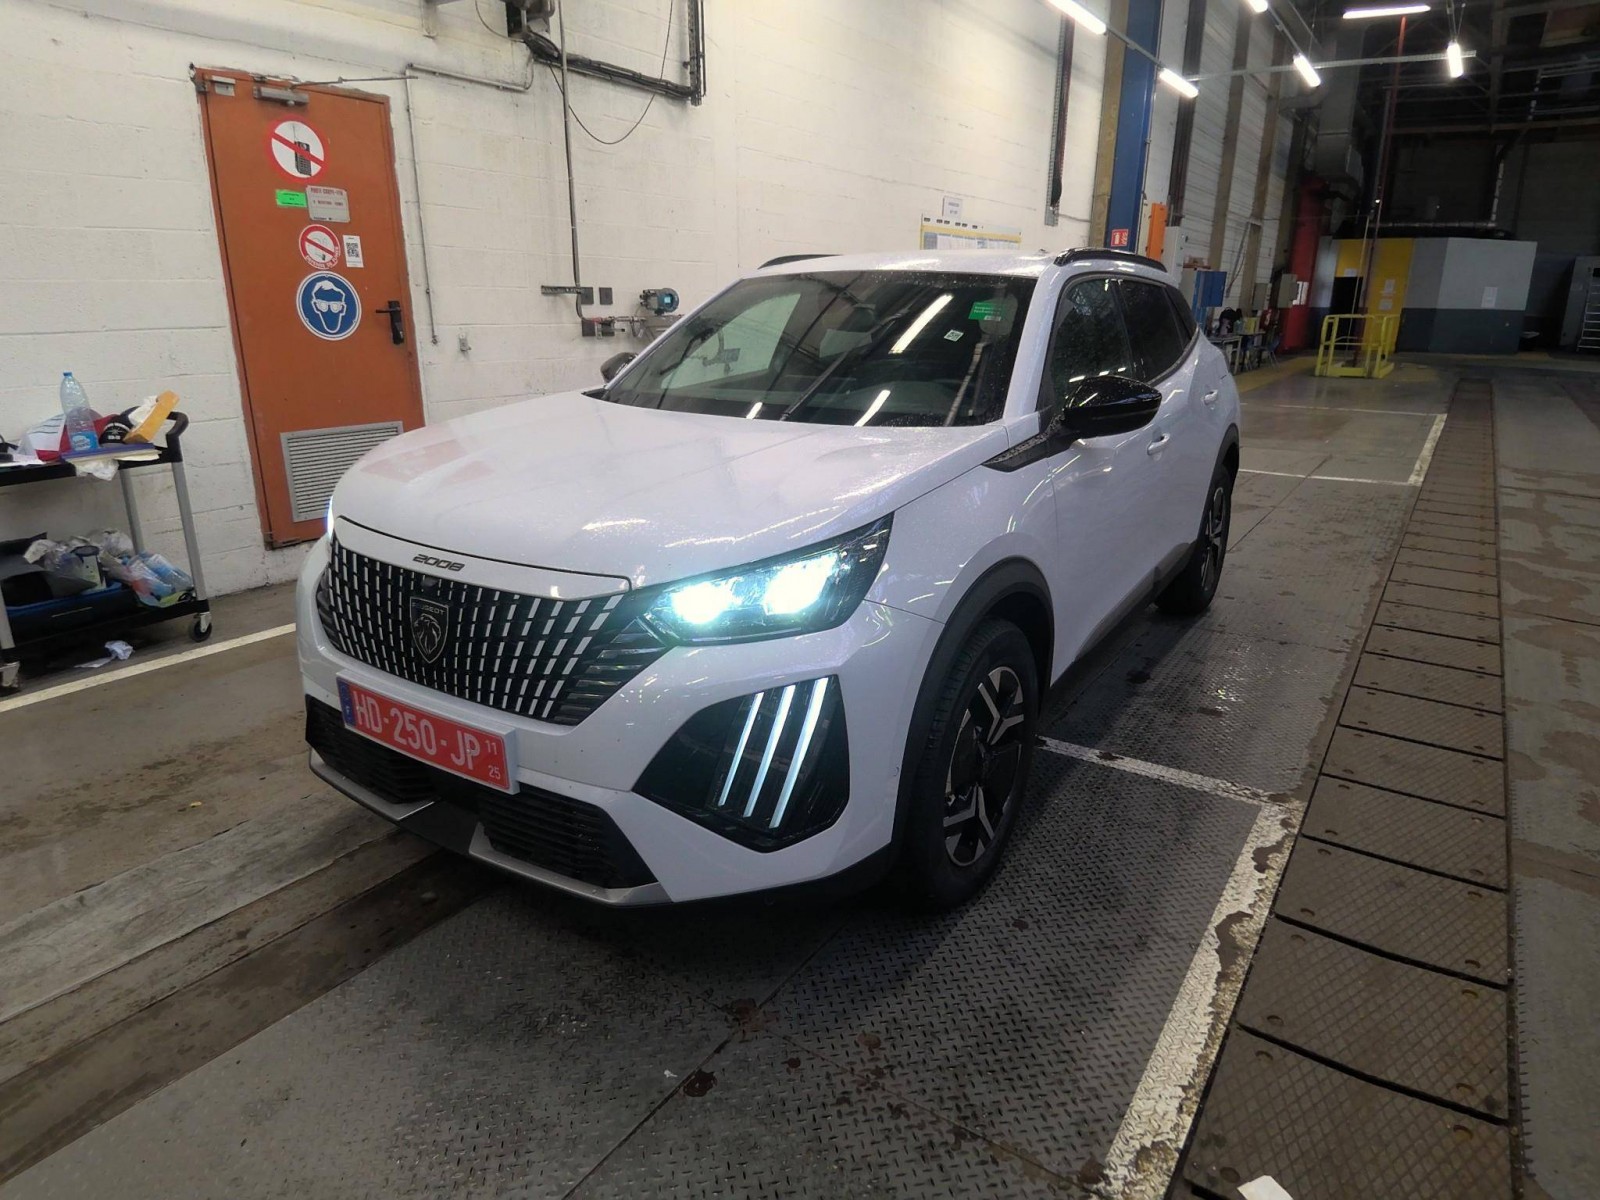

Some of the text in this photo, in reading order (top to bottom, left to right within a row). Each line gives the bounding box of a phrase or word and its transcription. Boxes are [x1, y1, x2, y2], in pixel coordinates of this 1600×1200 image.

[412, 554, 465, 572] 2008
[353, 690, 481, 771] HD-250-JP
[485, 739, 498, 755] 11
[487, 764, 501, 780] 25
